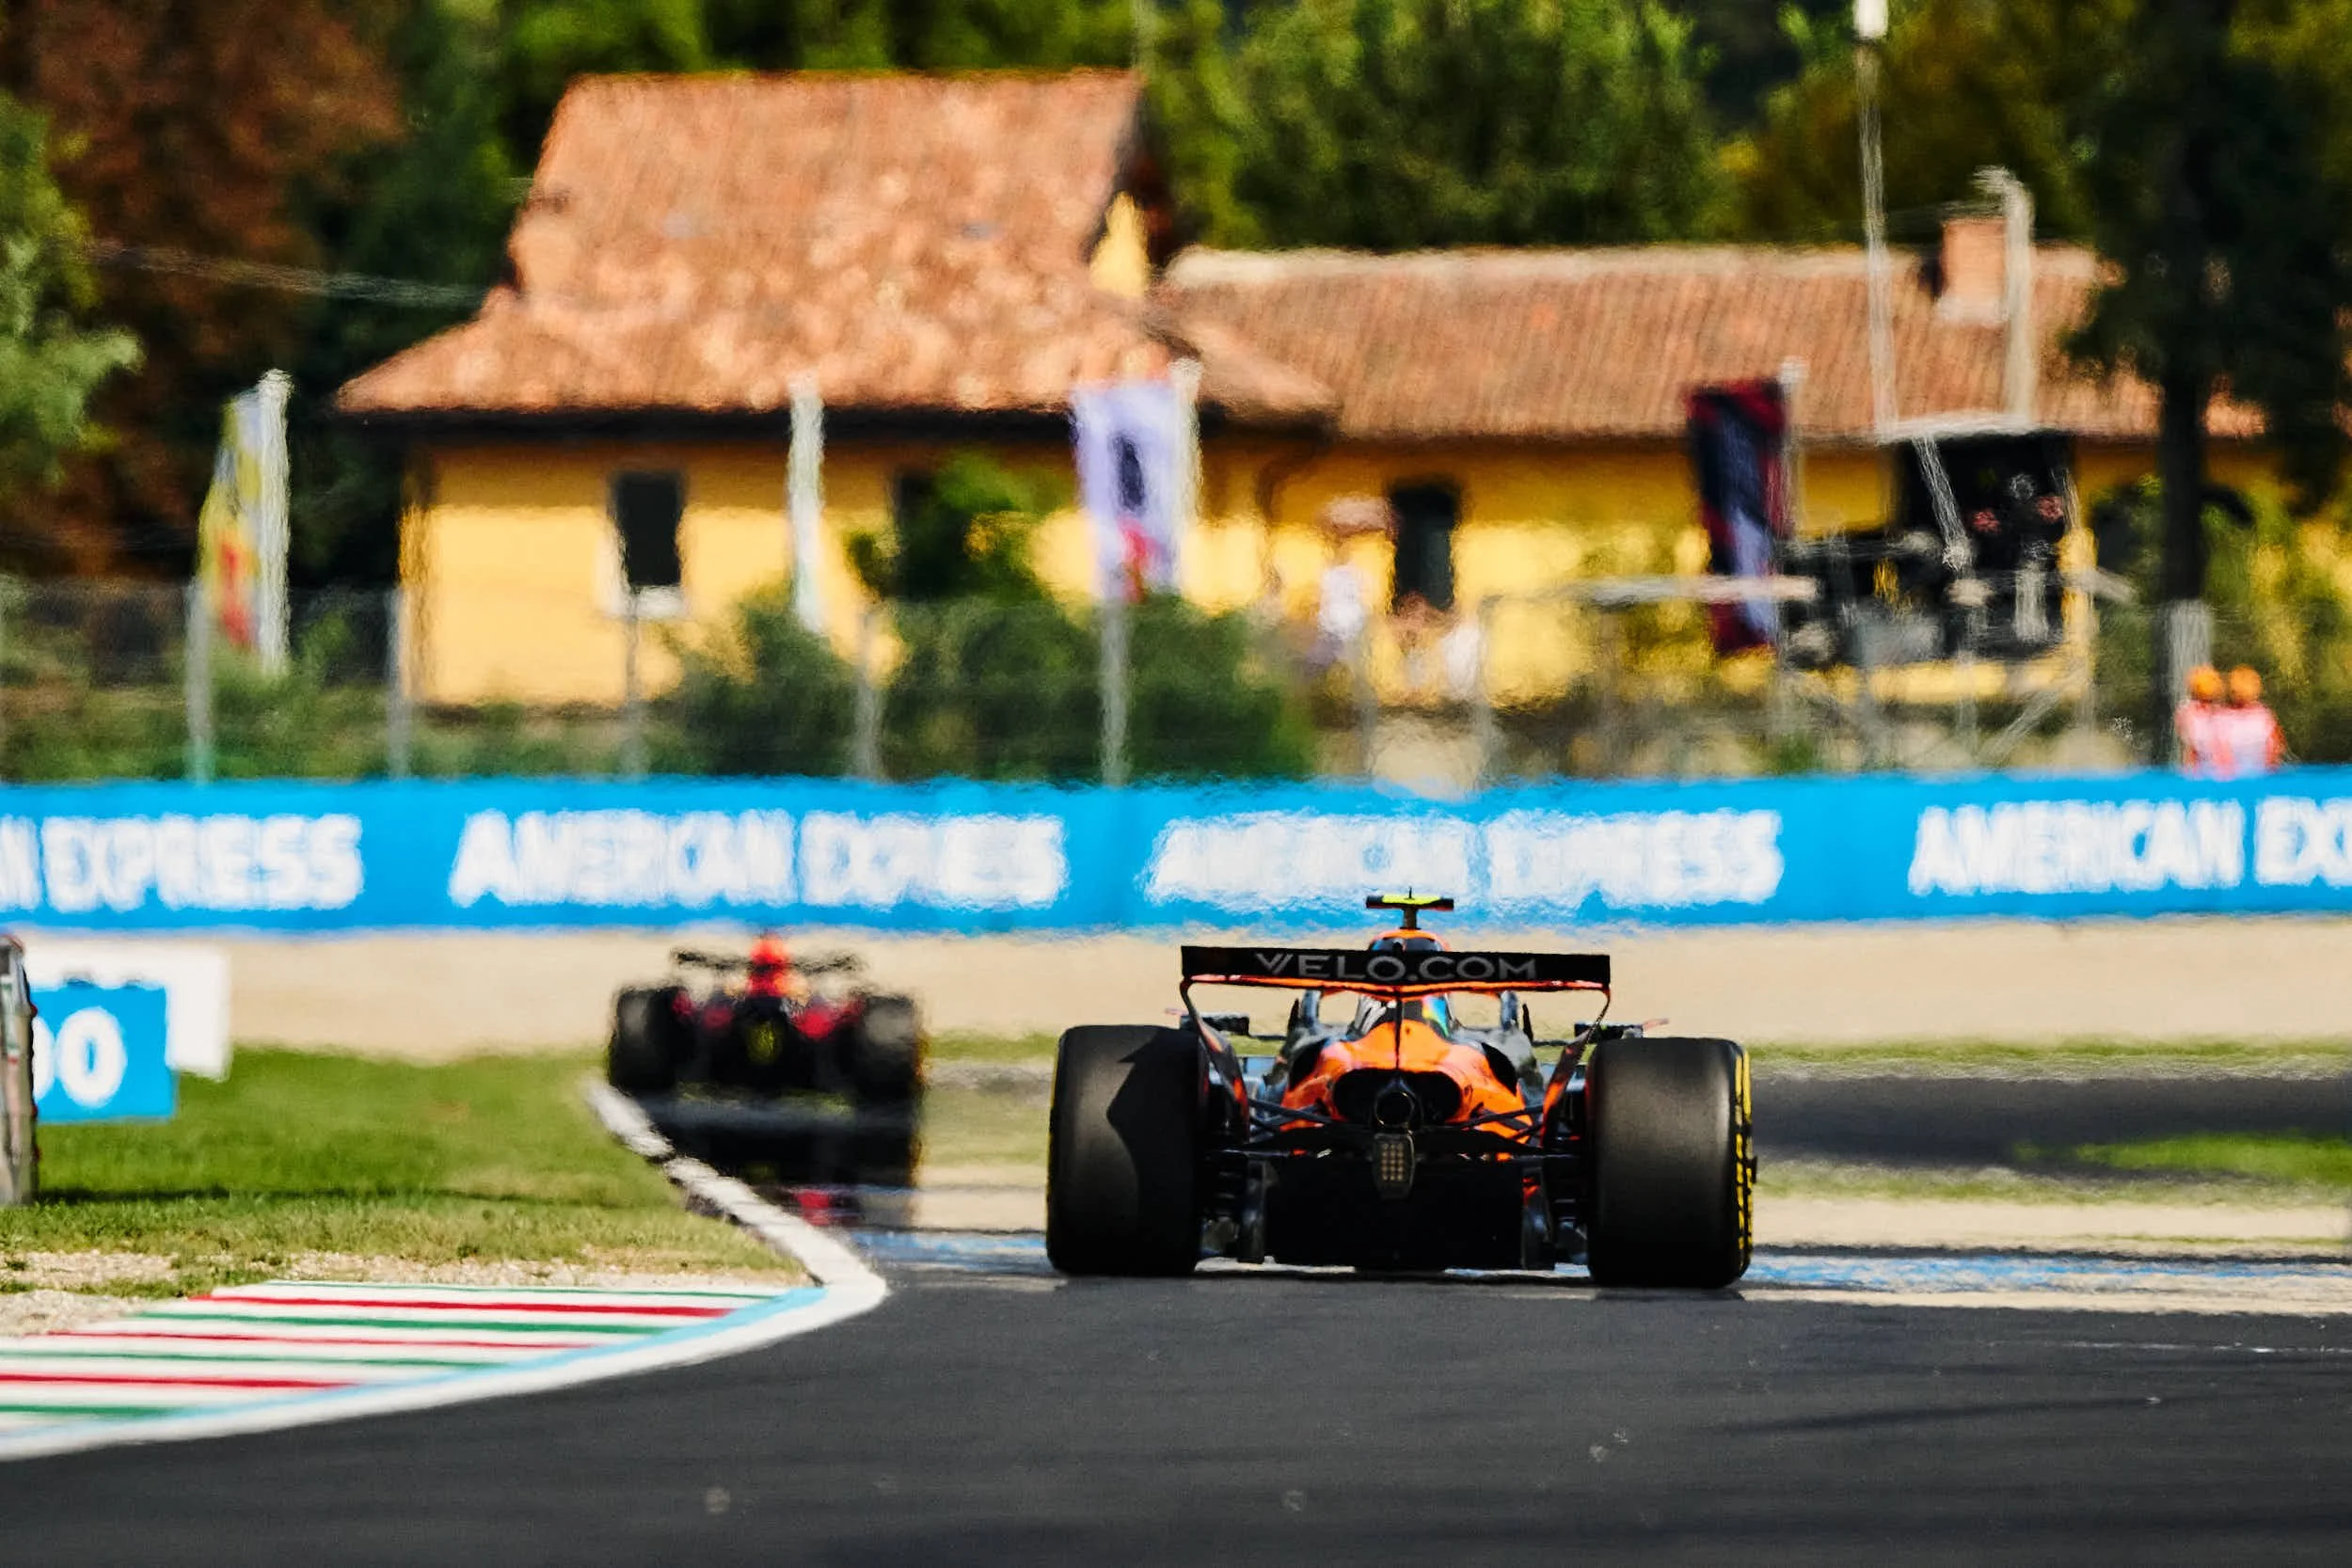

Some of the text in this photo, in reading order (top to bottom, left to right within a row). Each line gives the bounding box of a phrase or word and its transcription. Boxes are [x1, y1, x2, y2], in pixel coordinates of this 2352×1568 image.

[41, 813, 365, 911] EXPRESS
[449, 809, 795, 907] AMERICAN
[1908, 799, 2247, 896] AMERICAN
[1255, 952, 1537, 982] VELO.COM
